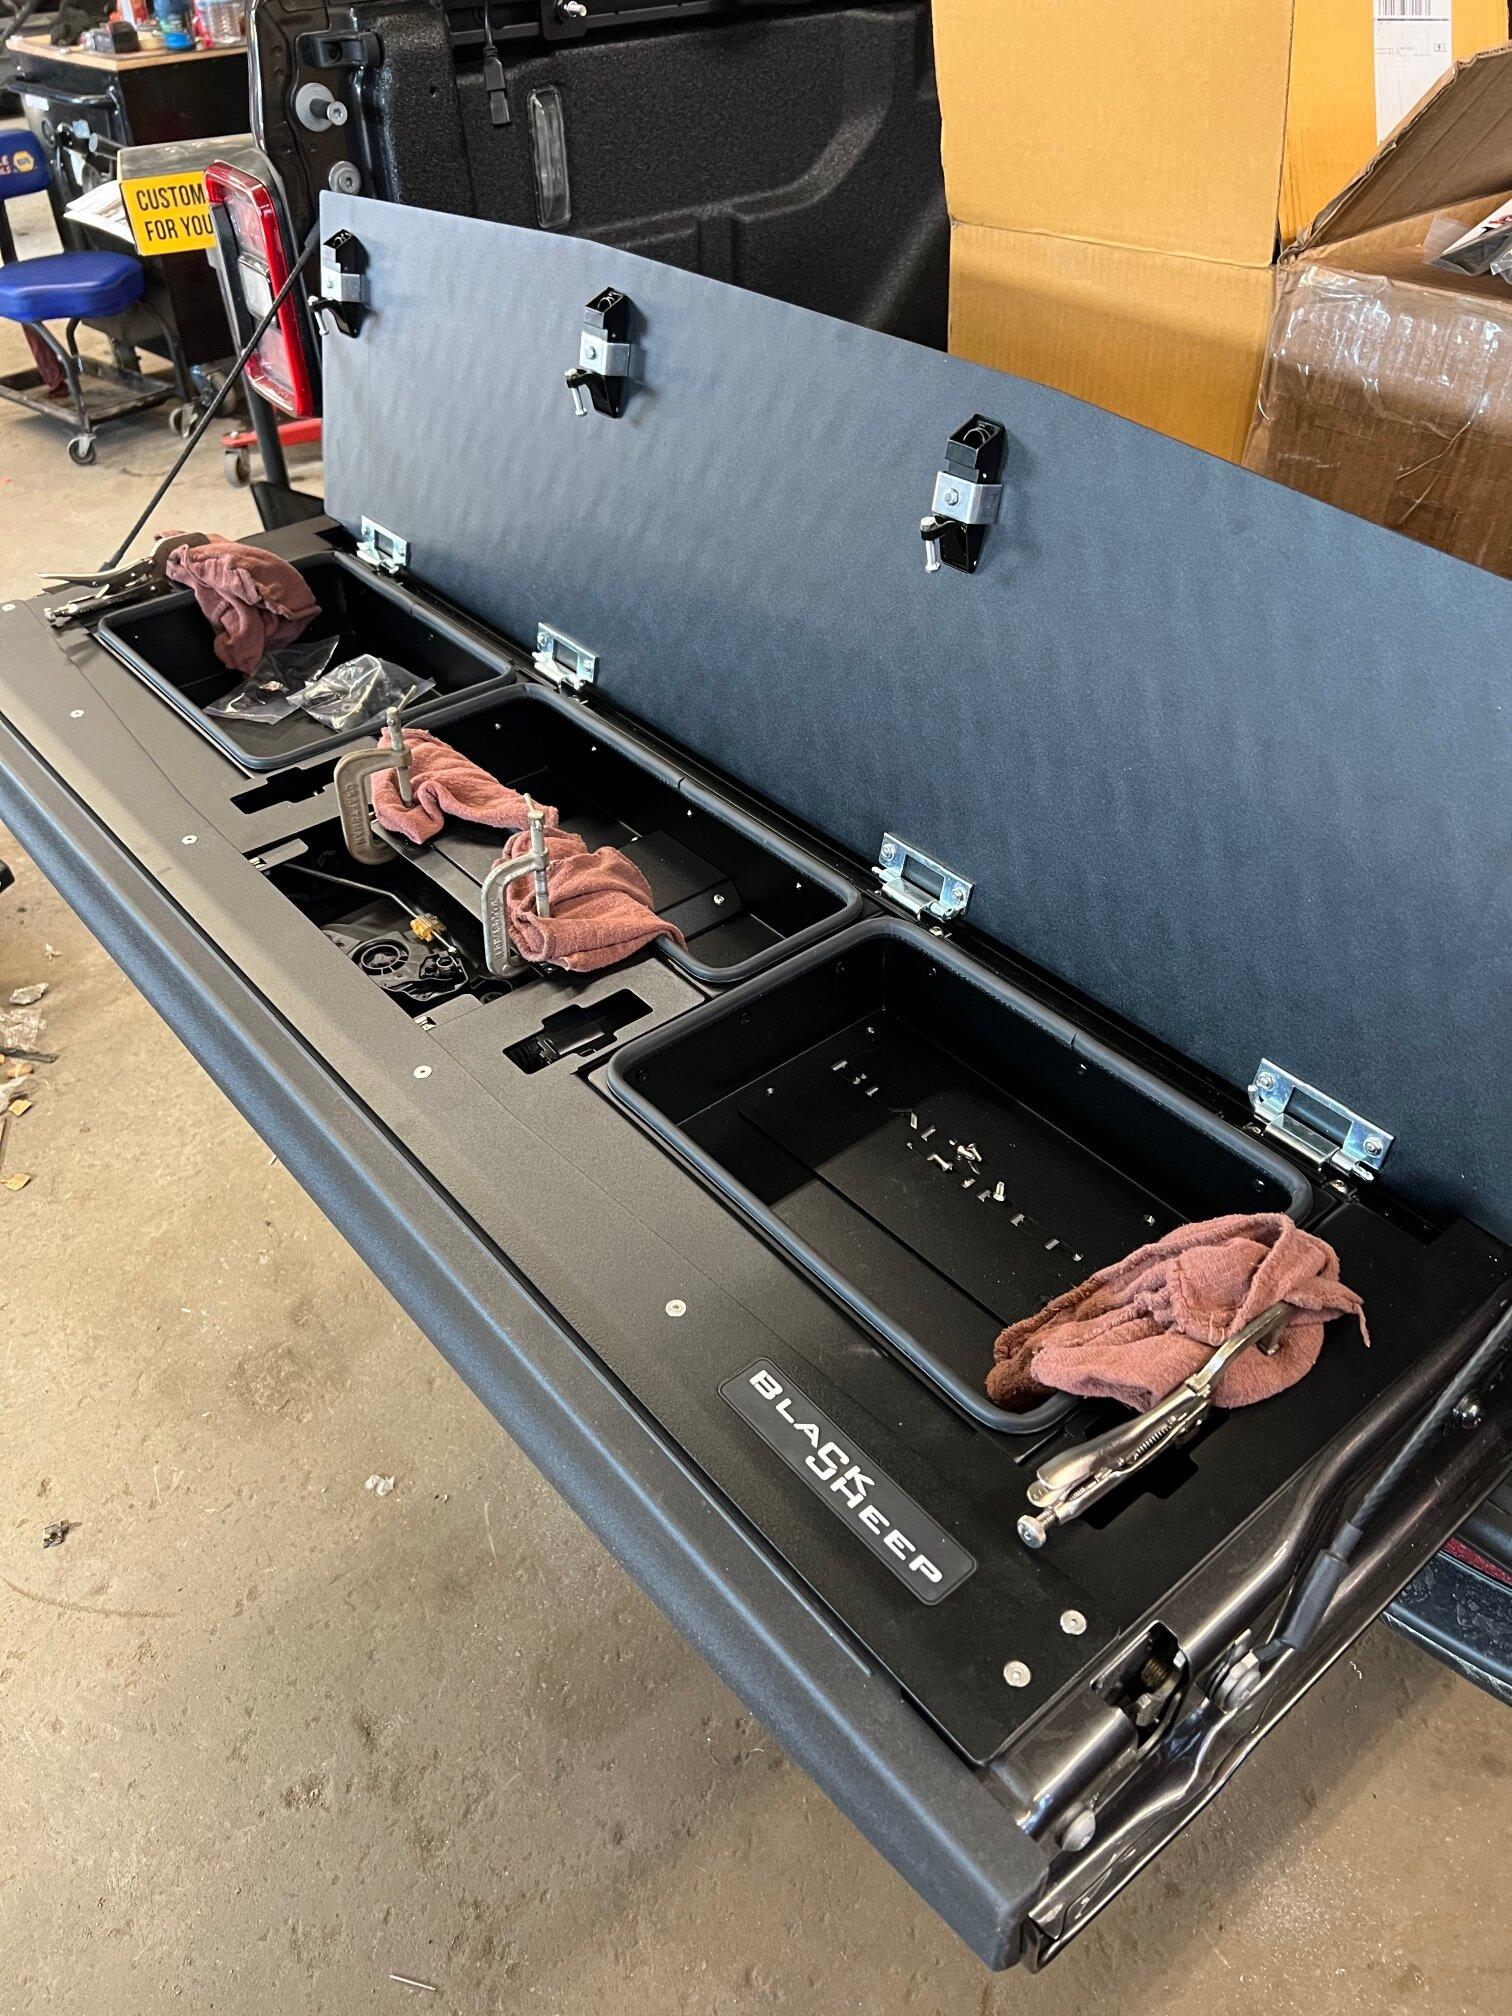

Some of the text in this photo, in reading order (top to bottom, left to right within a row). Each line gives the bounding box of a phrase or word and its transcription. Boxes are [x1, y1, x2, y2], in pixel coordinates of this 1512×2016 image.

[136, 183, 206, 211] CUSTOM
[144, 214, 214, 241] FOR YOU
[749, 1369, 876, 1497] BLACK
[805, 1455, 943, 1583] SHEEP
